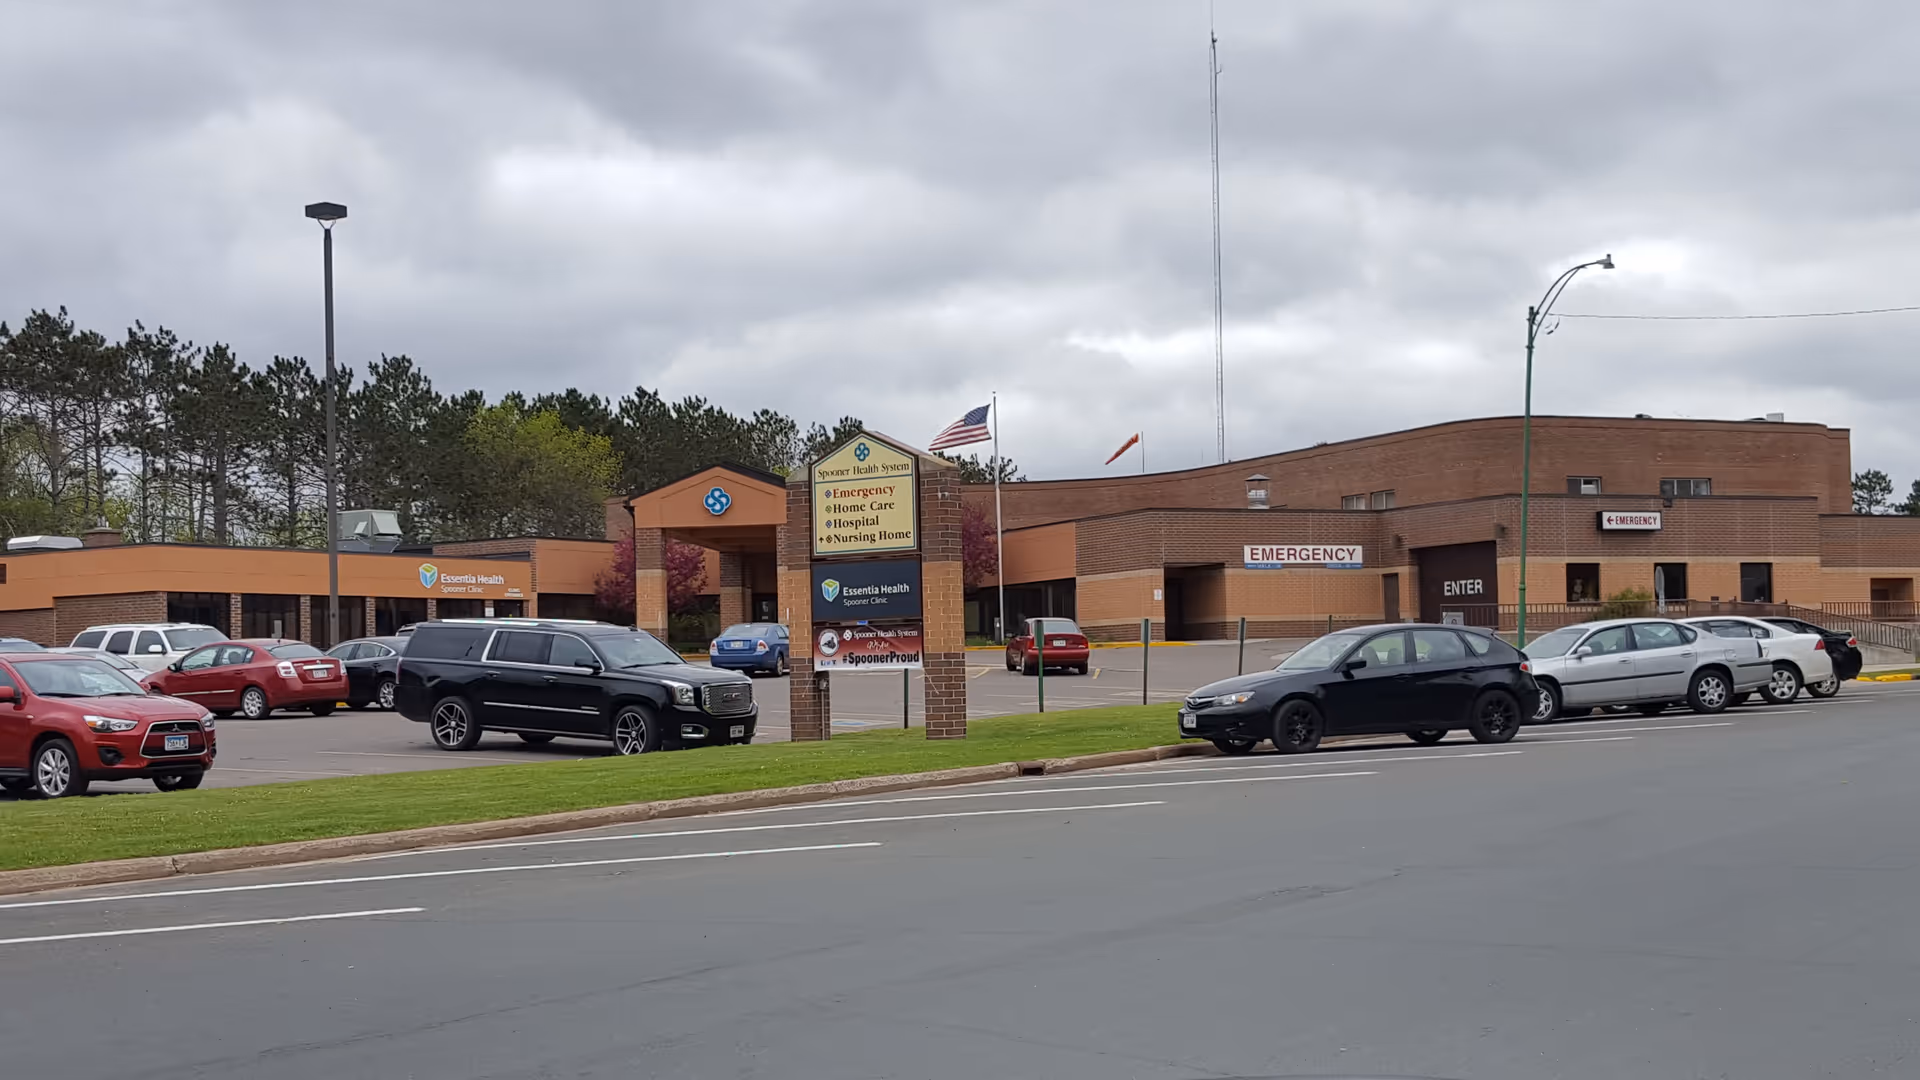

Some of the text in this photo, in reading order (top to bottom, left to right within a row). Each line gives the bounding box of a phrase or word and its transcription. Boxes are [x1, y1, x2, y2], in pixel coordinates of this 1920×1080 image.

[817, 463, 910, 479] Spooner Health System
[832, 485, 896, 499] Emergency
[833, 501, 895, 514] Home Care
[833, 515, 879, 530] Hospital
[1615, 516, 1657, 525] EMERGENCY
[833, 530, 912, 544] Nursing Home
[1250, 547, 1356, 561] EMERGENCY
[441, 573, 504, 585] Essentia Health
[441, 585, 466, 593] Spooner
[843, 583, 910, 596] Essentia Health
[1444, 579, 1483, 596] ENTER
[843, 596, 888, 607] Spooner Clinic
[853, 629, 918, 639] Spooner Health System
[842, 650, 920, 667] #SpoonerProud
